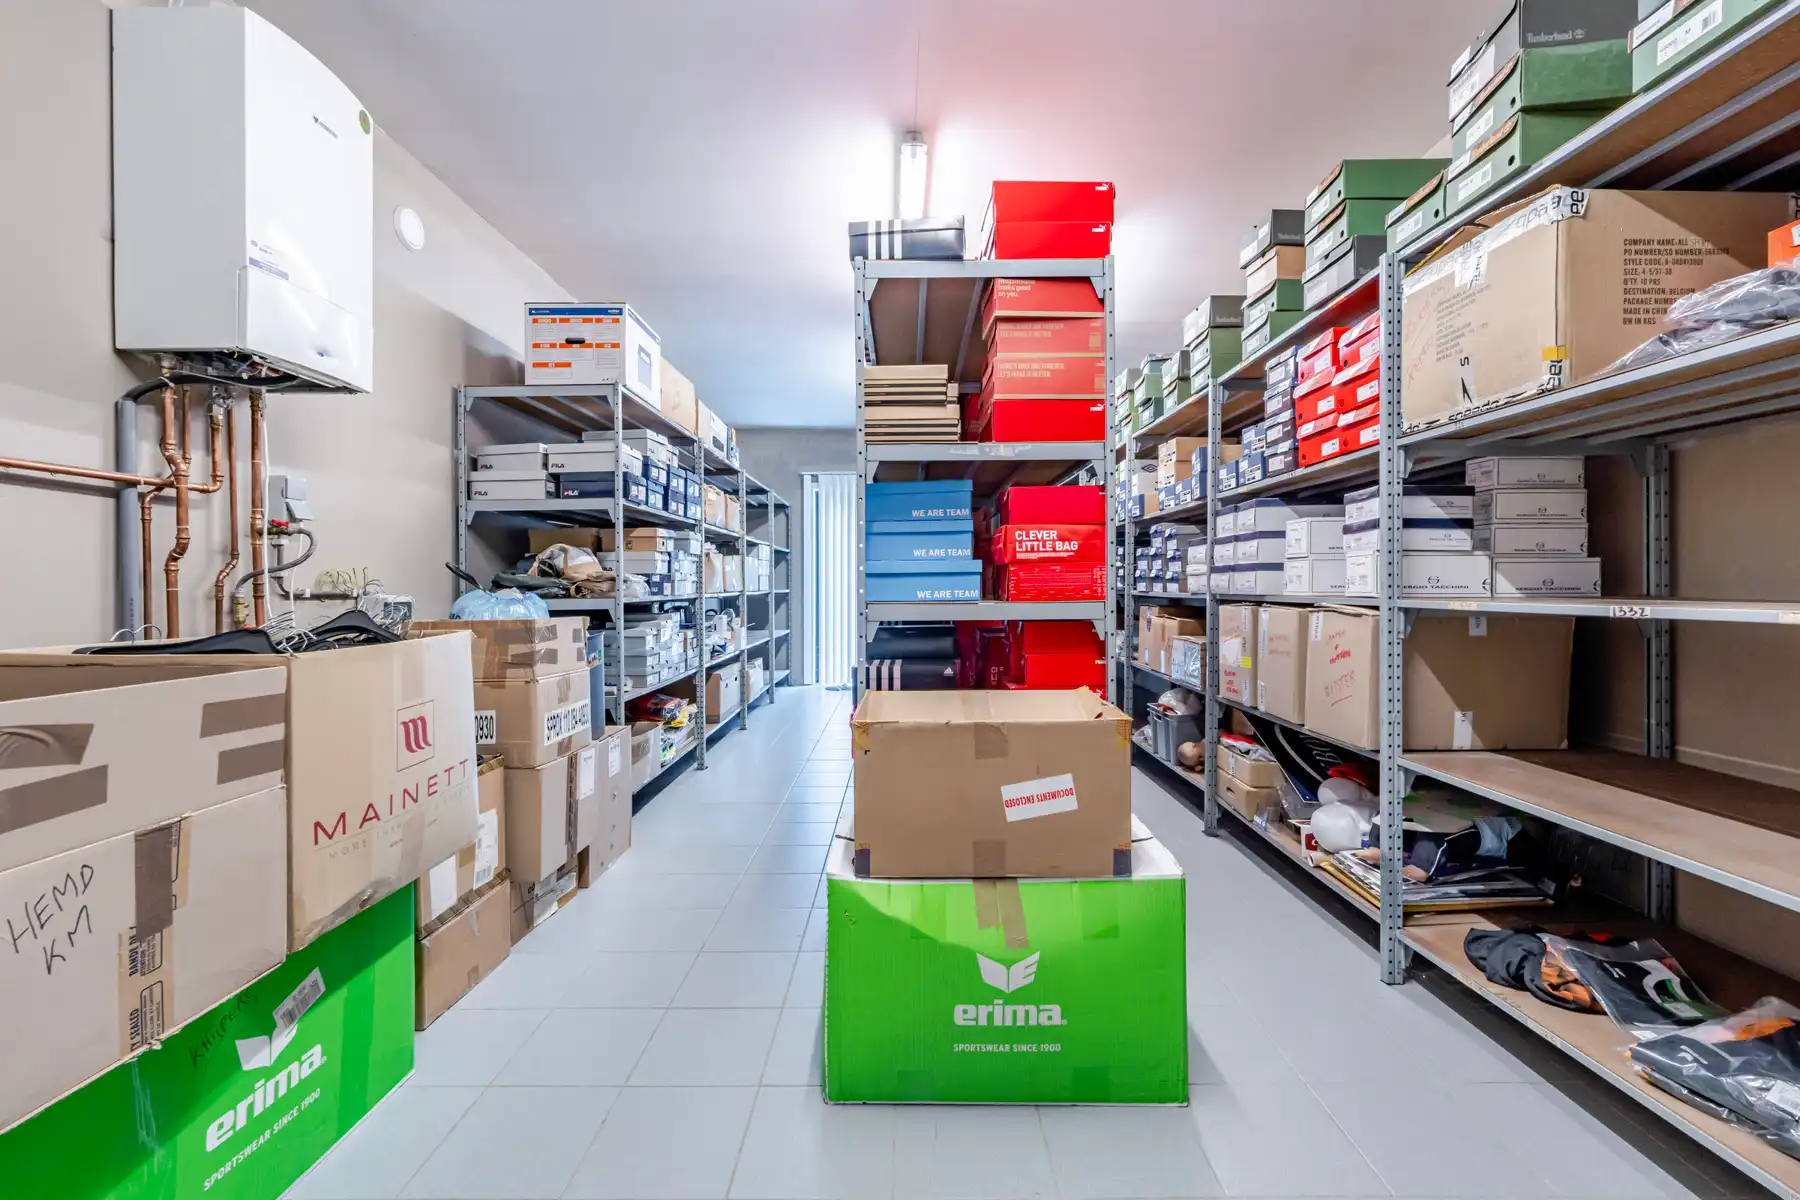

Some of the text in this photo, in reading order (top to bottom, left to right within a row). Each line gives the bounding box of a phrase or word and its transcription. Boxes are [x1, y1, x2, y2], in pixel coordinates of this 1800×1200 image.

[1527, 30, 1572, 43] Timberland
[1634, 317, 1642, 325] IN
[1644, 317, 1656, 325] KGS
[564, 489, 580, 497] FILA
[911, 508, 970, 517] WE ARE TEAM
[1015, 530, 1058, 540] CLEVER
[1015, 541, 1079, 551] LITTLE BAG
[913, 548, 971, 557] WE ARE TEAM
[917, 589, 979, 598] WE ARE TEAM
[1612, 606, 1649, 617] 1332
[1004, 787, 1075, 808] DOCUMENTS ENCLOSED
[7, 864, 94, 954] HEMD
[953, 998, 1062, 1026] erima
[128, 1009, 140, 1039] SEALED
[953, 1043, 1062, 1052] SPORTSWEAR SINCE 1900
[205, 1043, 322, 1153] erima
[203, 1087, 321, 1192] SPORTSWEAR SINCE 1900
